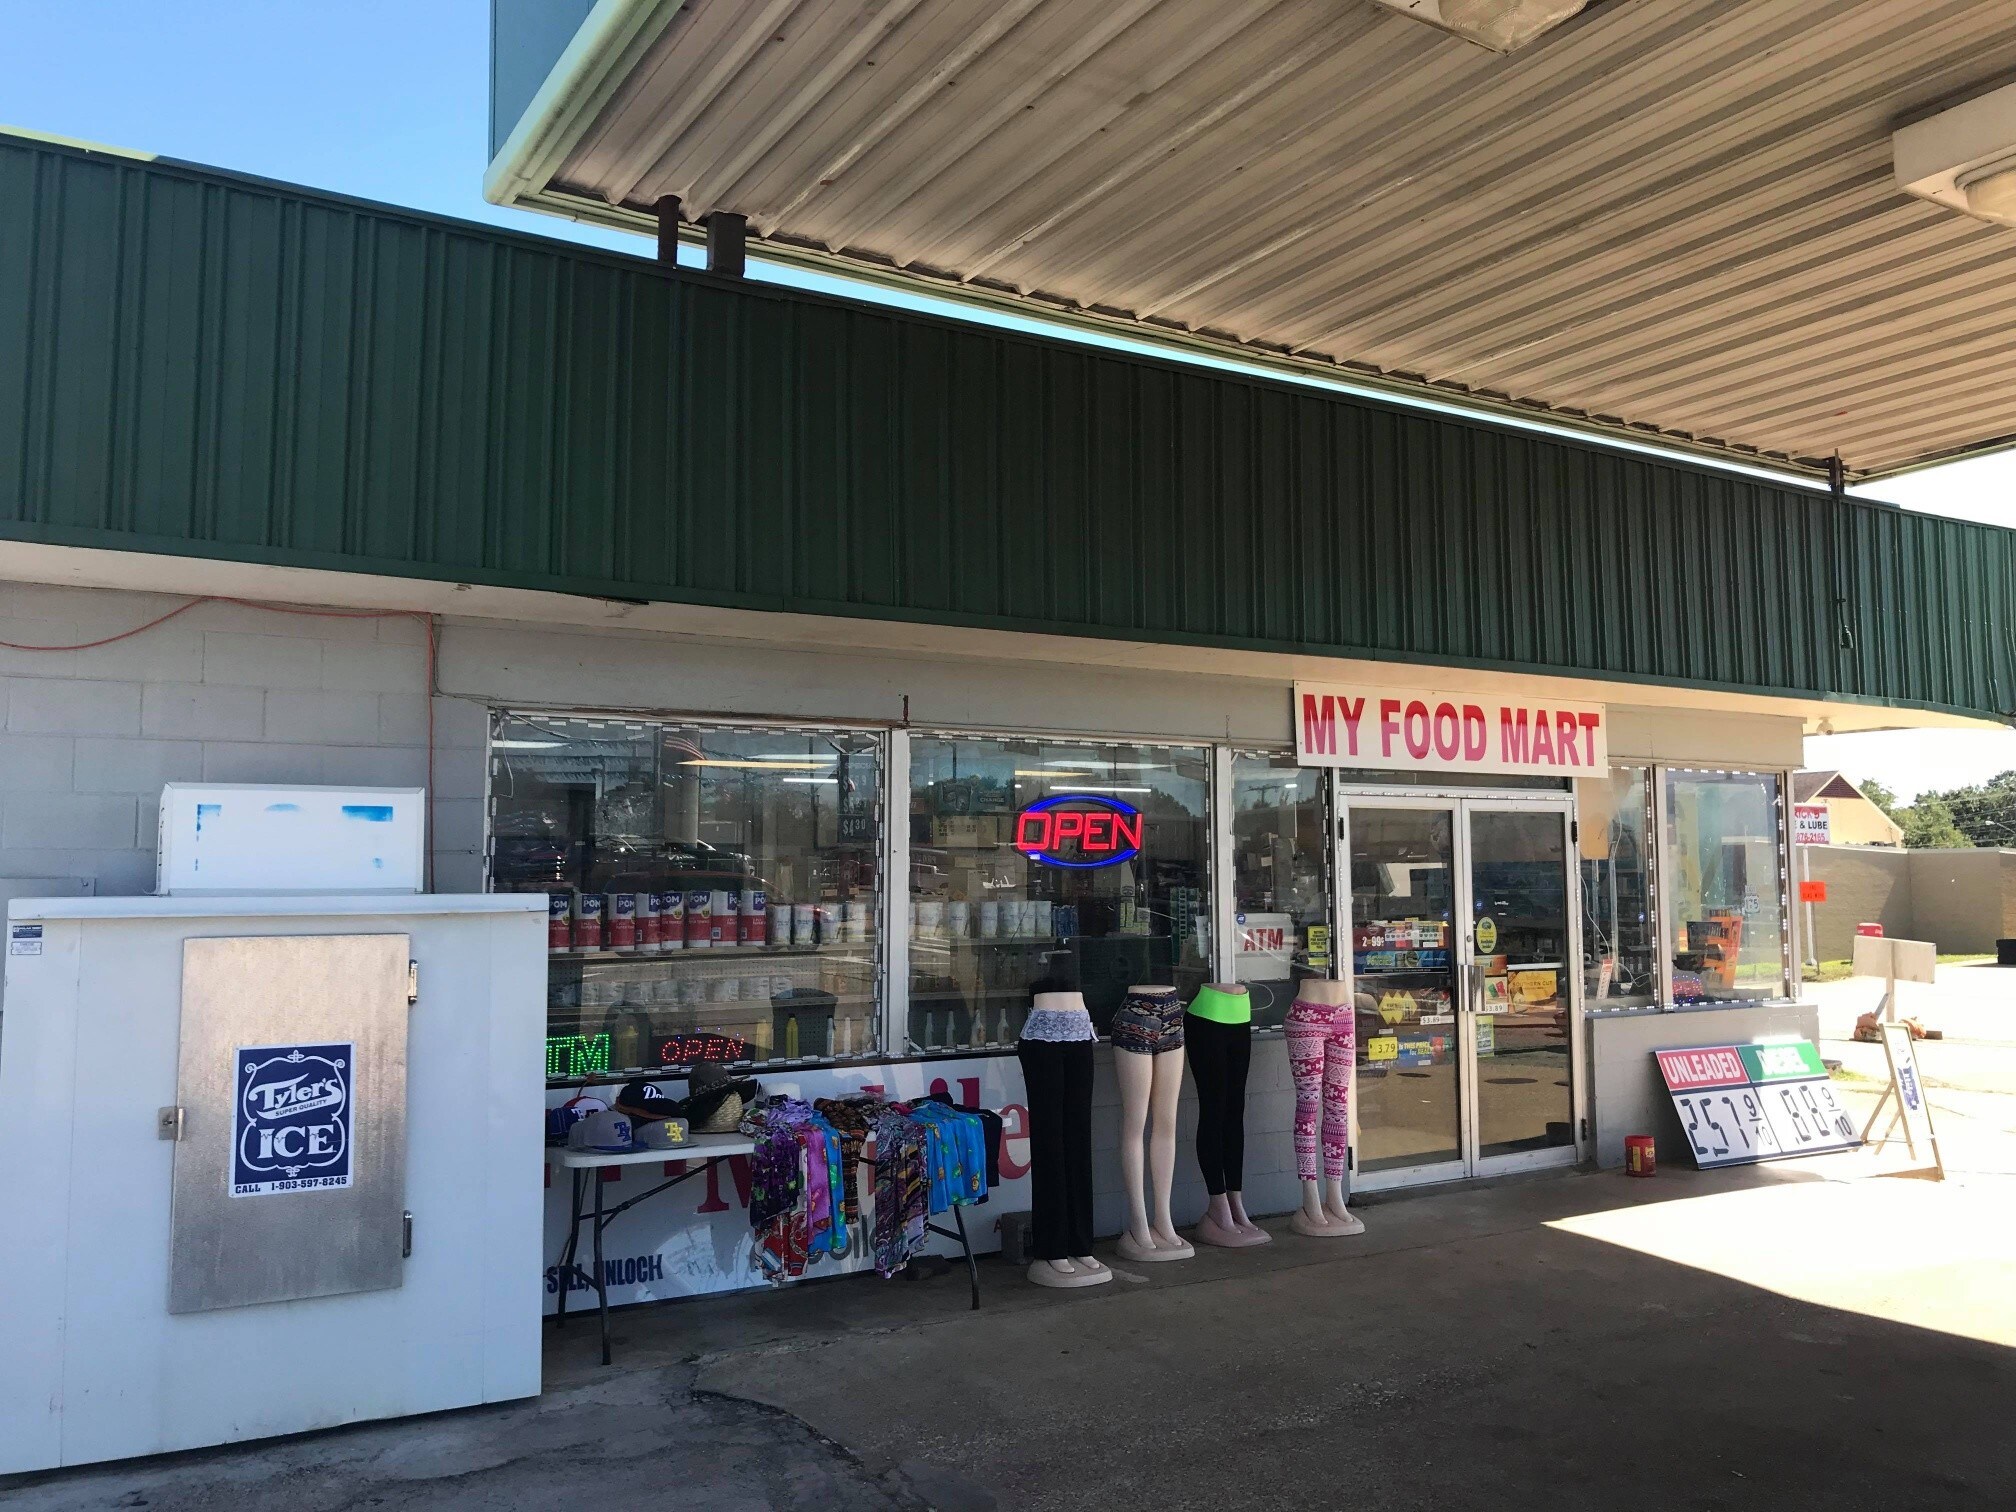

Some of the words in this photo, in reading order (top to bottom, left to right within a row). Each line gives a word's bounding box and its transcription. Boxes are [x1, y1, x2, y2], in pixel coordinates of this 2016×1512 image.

[1303, 694, 1365, 756] MY
[1380, 699, 1487, 762] FOOD
[1500, 707, 1600, 767] MART
[1017, 812, 1143, 851] OPEN
[1799, 820, 1806, 829] &
[1808, 821, 1828, 830] LUBE
[1243, 928, 1284, 952] ATM
[546, 1034, 610, 1076] TM
[661, 1038, 746, 1062] OPEN
[1663, 1052, 1742, 1084] UNLEADED
[248, 1073, 343, 1113] Tyler's
[275, 1106, 298, 1117] SUPER
[299, 1099, 327, 1110] QUALITY
[257, 1124, 338, 1159] ICE
[1836, 1116, 1853, 1137] 10
[235, 1184, 261, 1194] CALL
[271, 1177, 347, 1191] 1-903-597-8245
[546, 1263, 590, 1294] SLL,
[594, 1254, 664, 1286] NLOCK
